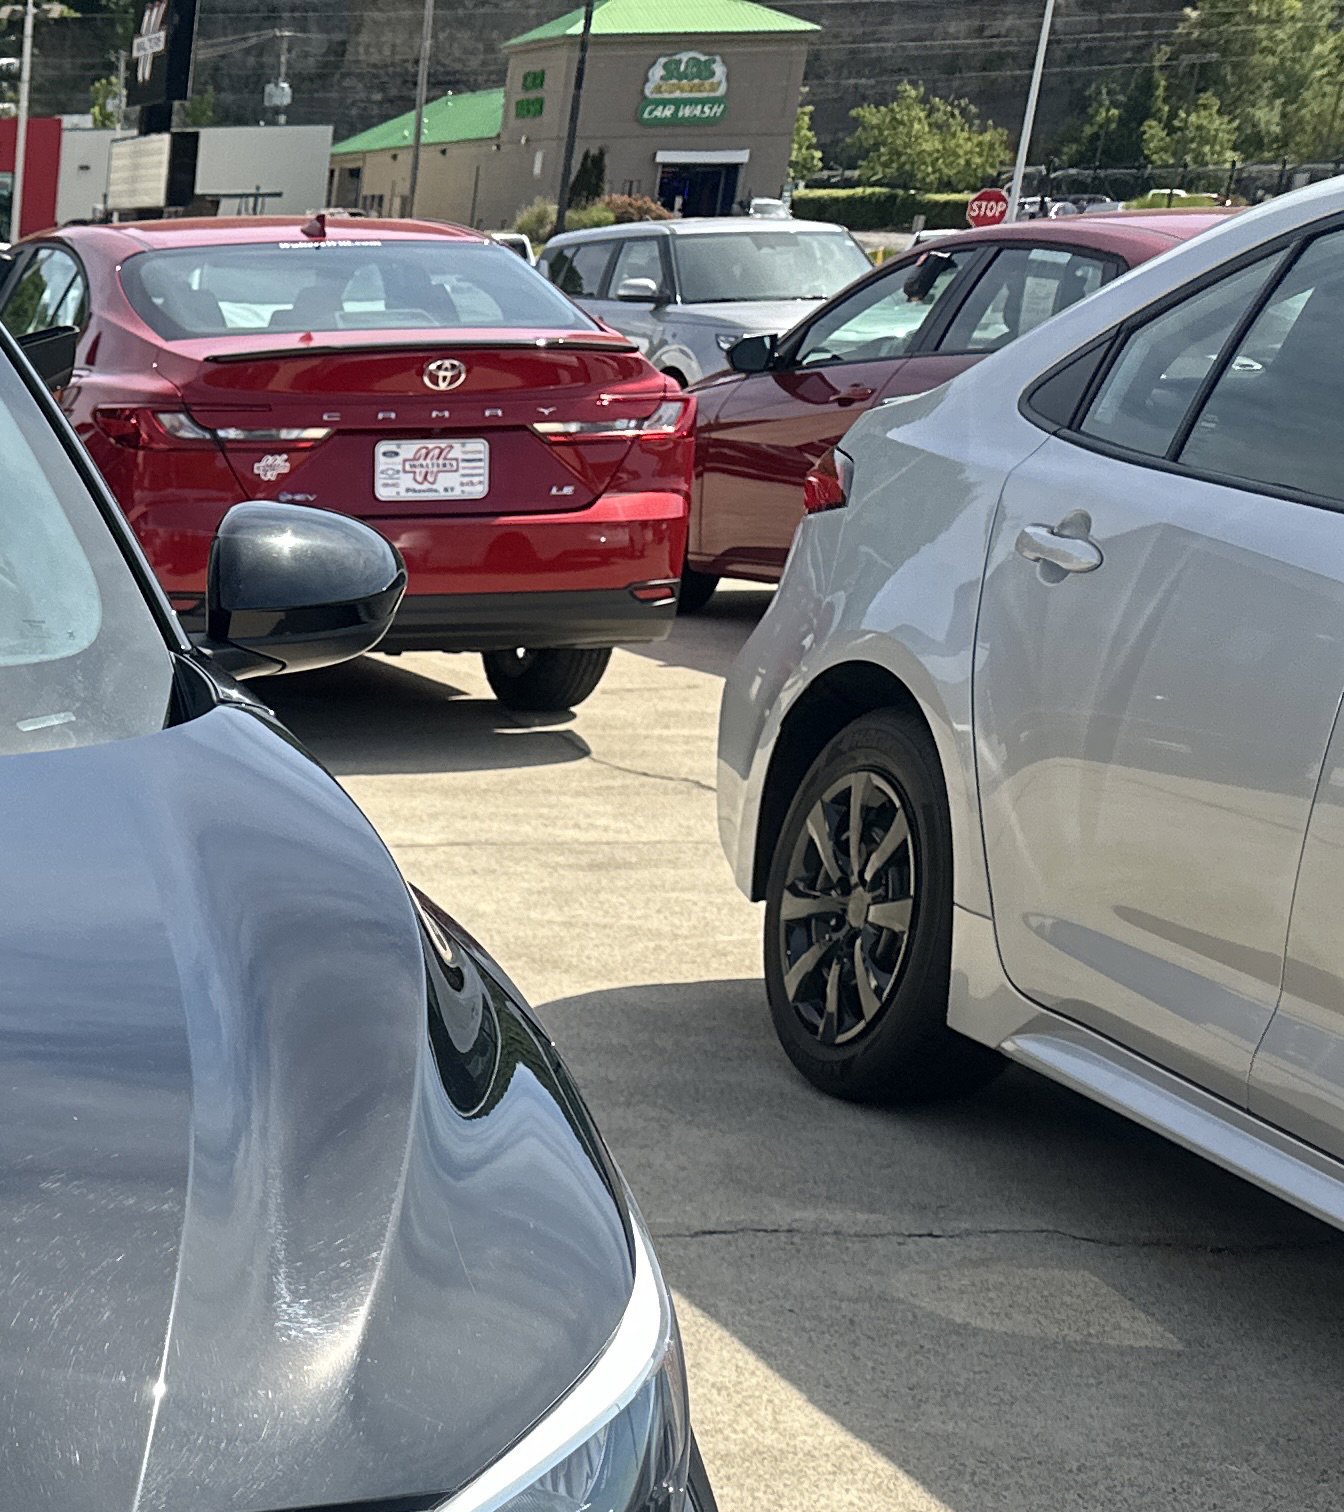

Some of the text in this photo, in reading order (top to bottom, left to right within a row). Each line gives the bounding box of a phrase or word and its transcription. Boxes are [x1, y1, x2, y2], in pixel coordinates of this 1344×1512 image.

[643, 103, 724, 118] CAR WASH
[970, 200, 1007, 217] STOP
[323, 406, 557, 421] CAMRY
[549, 485, 575, 495] LE
